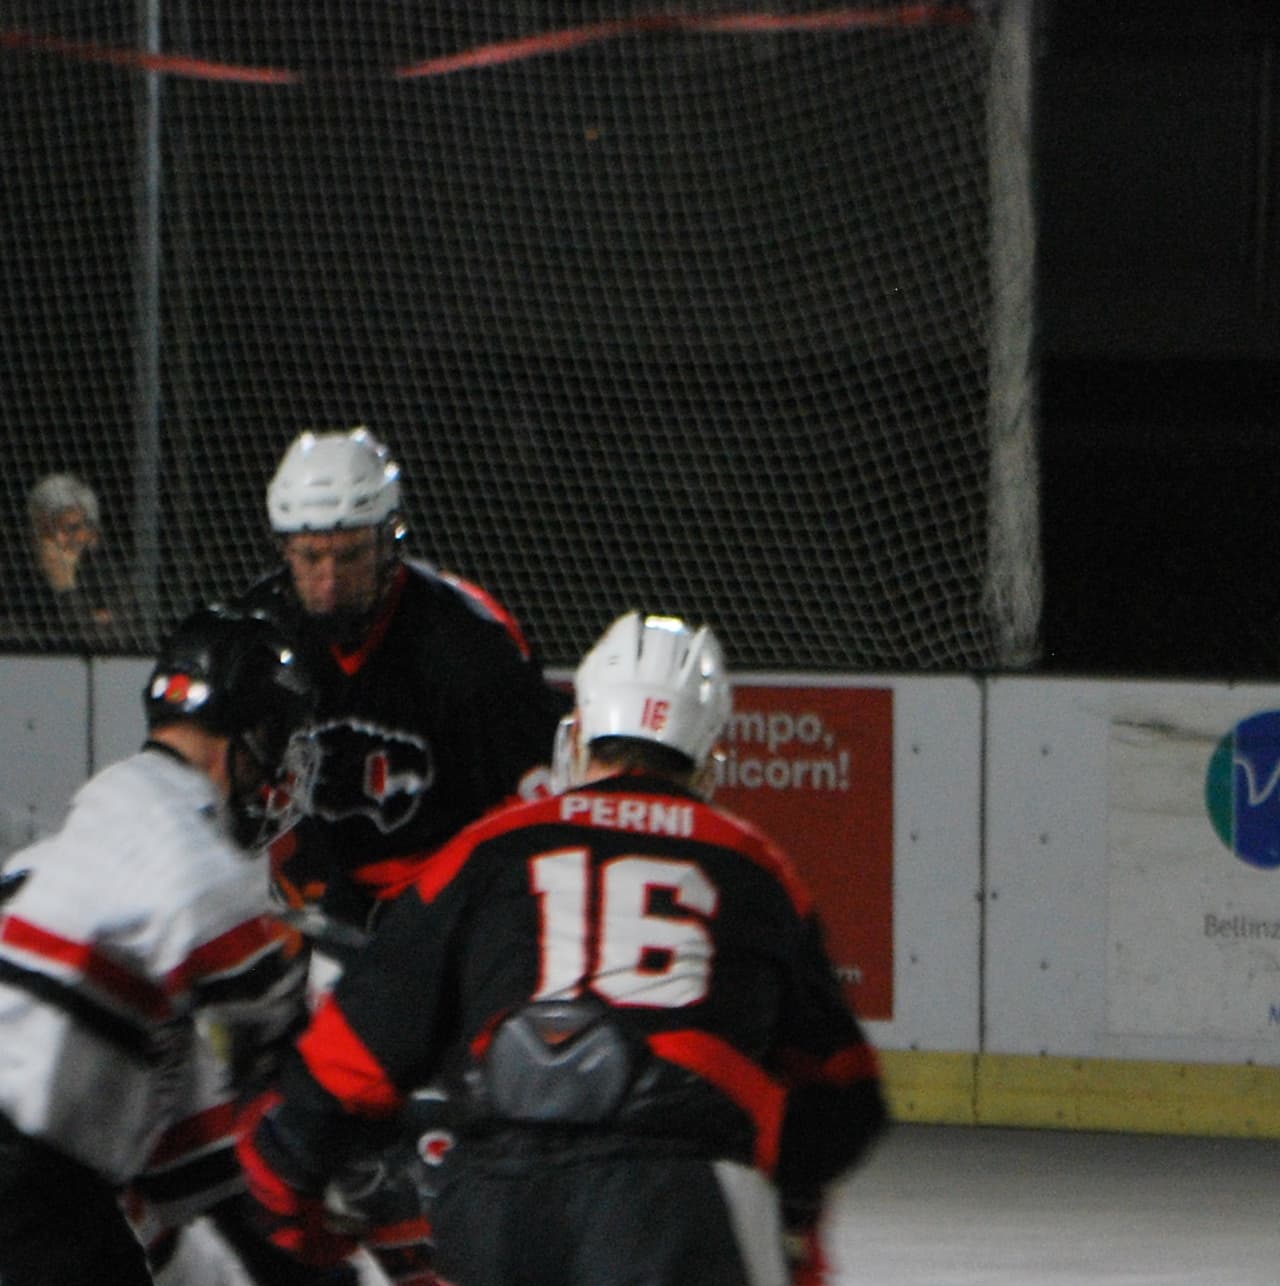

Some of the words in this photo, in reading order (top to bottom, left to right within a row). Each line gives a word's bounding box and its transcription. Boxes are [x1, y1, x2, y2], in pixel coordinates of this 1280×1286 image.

[641, 697, 670, 731] 16
[726, 712, 834, 750] mpo,
[560, 796, 694, 837] PERNI
[527, 847, 719, 1010] 16
